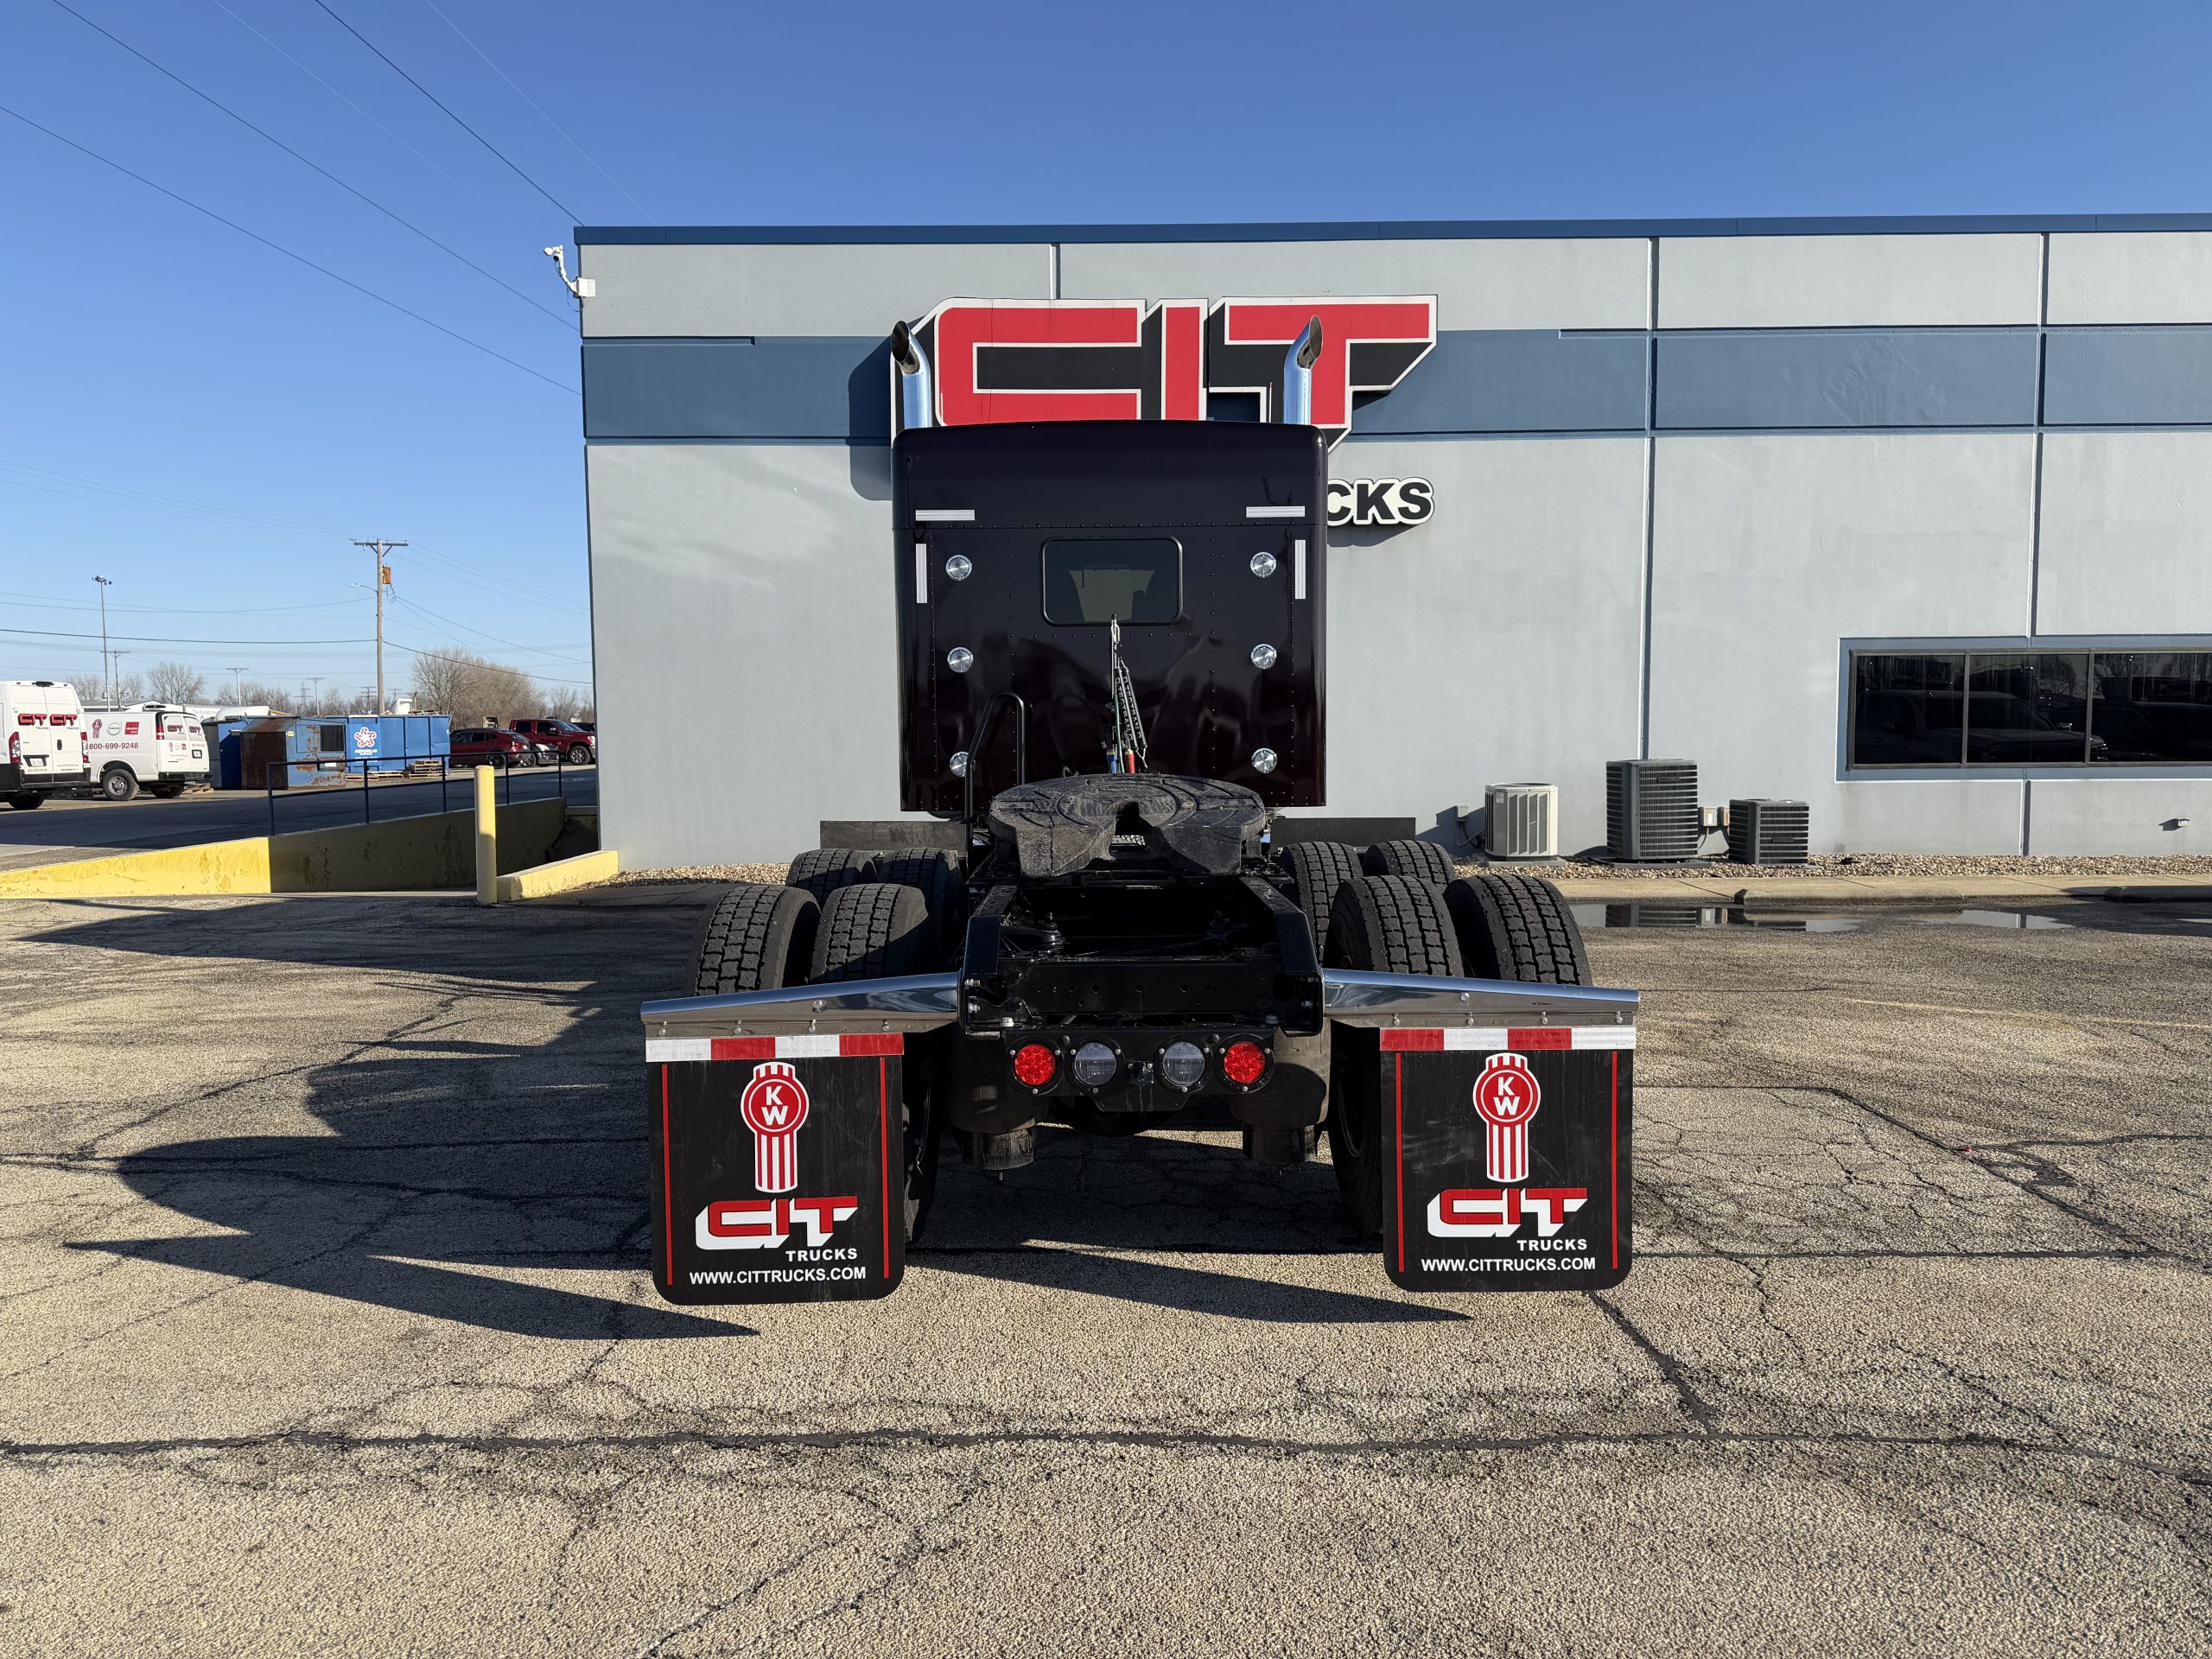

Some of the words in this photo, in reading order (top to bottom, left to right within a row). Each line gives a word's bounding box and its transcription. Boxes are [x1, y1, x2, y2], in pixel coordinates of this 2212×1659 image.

[892, 296, 1437, 449] CIT
[1328, 477, 1435, 527] CKS
[17, 714, 48, 726] CIT
[49, 714, 78, 726] CIT
[1427, 1187, 1588, 1237] CIT
[695, 1196, 858, 1249] CIT
[1517, 1238, 1587, 1251] TRUCKS
[785, 1248, 857, 1262] TRUCKS
[1421, 1257, 1596, 1272] WWW.CITTRUCKS.COM
[690, 1267, 866, 1284] WWW.CITTRUCKS.COM
